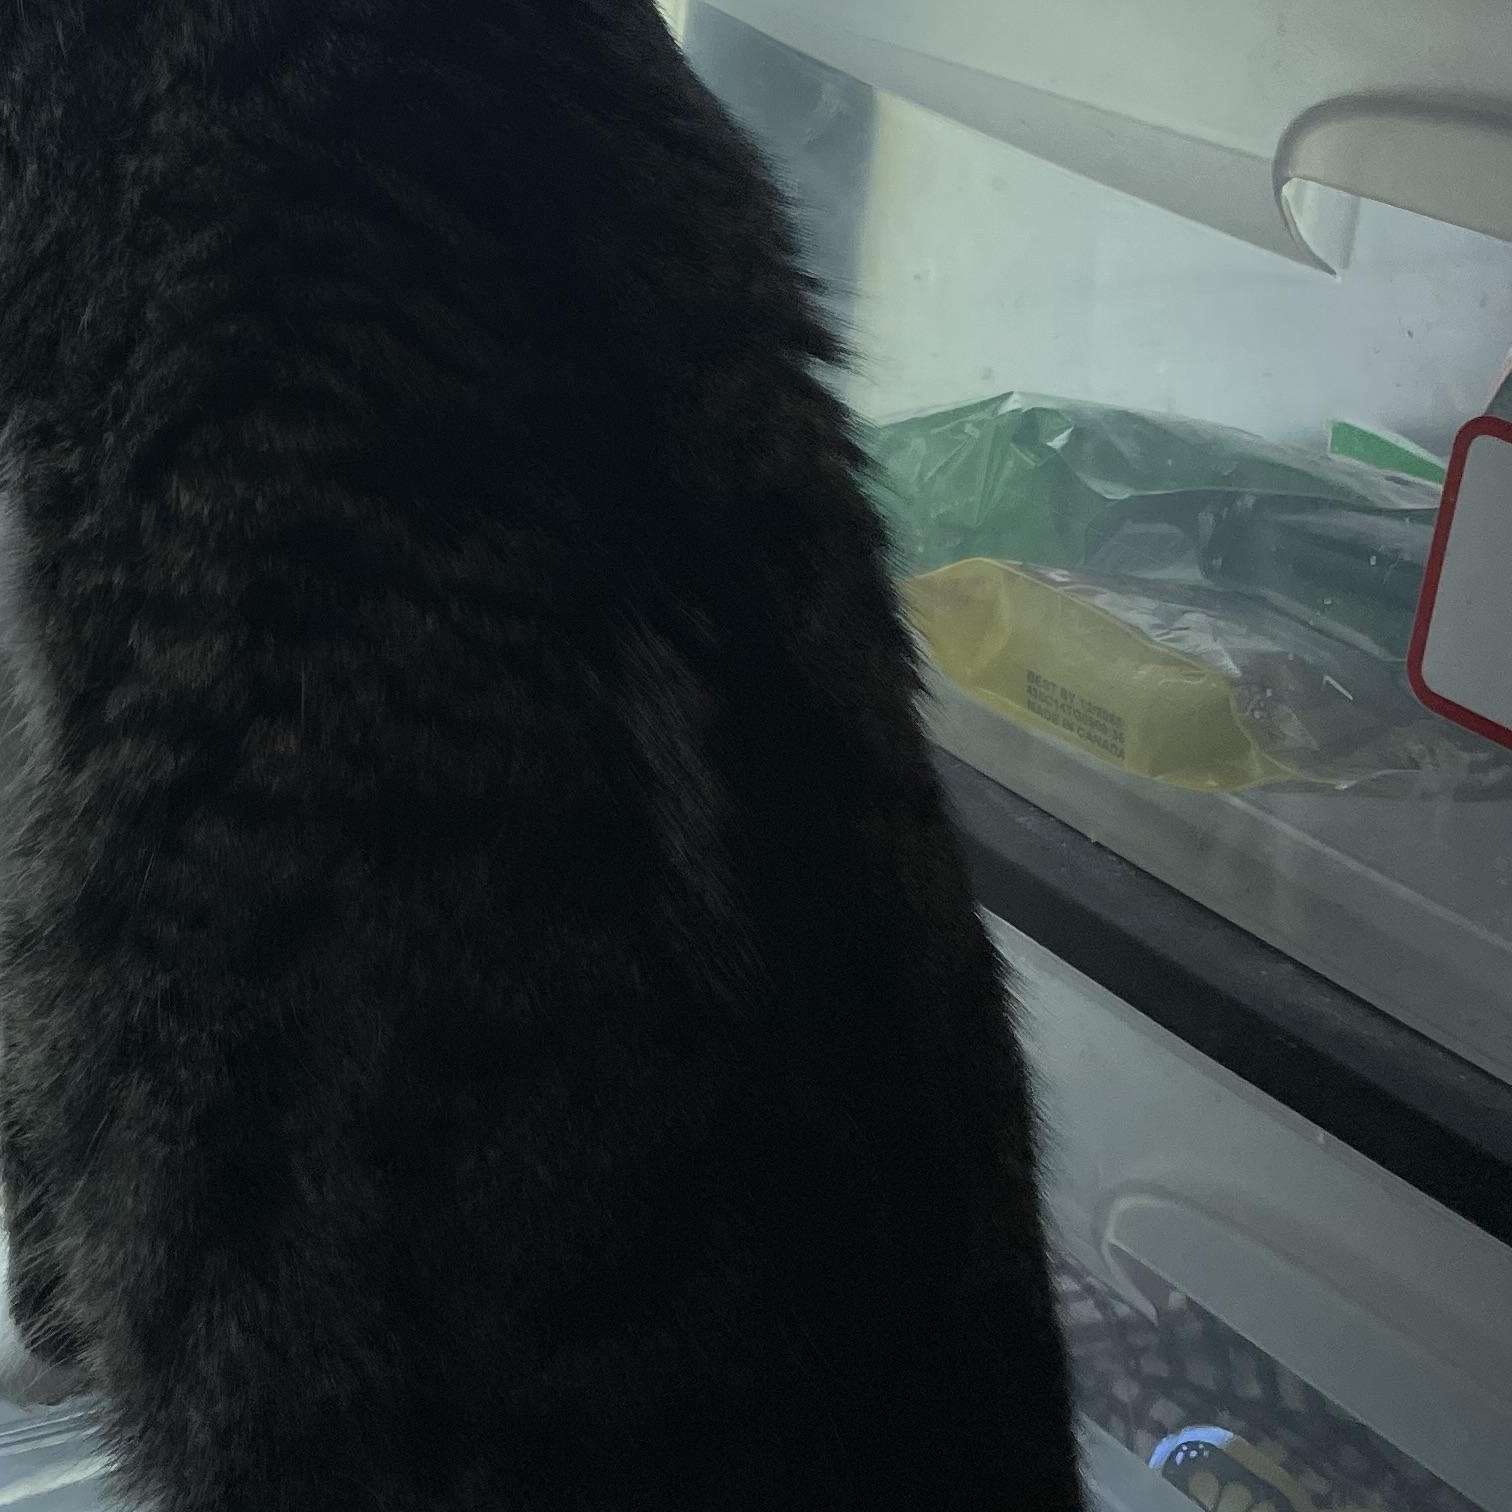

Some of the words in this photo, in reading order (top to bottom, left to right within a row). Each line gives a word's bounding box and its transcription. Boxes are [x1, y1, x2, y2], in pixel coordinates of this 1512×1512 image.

[1026, 670, 1056, 694] BEST
[1059, 686, 1075, 704] BY
[1026, 698, 1059, 726] MADE
[1062, 717, 1074, 733] IN
[1076, 726, 1126, 761] CANADA
